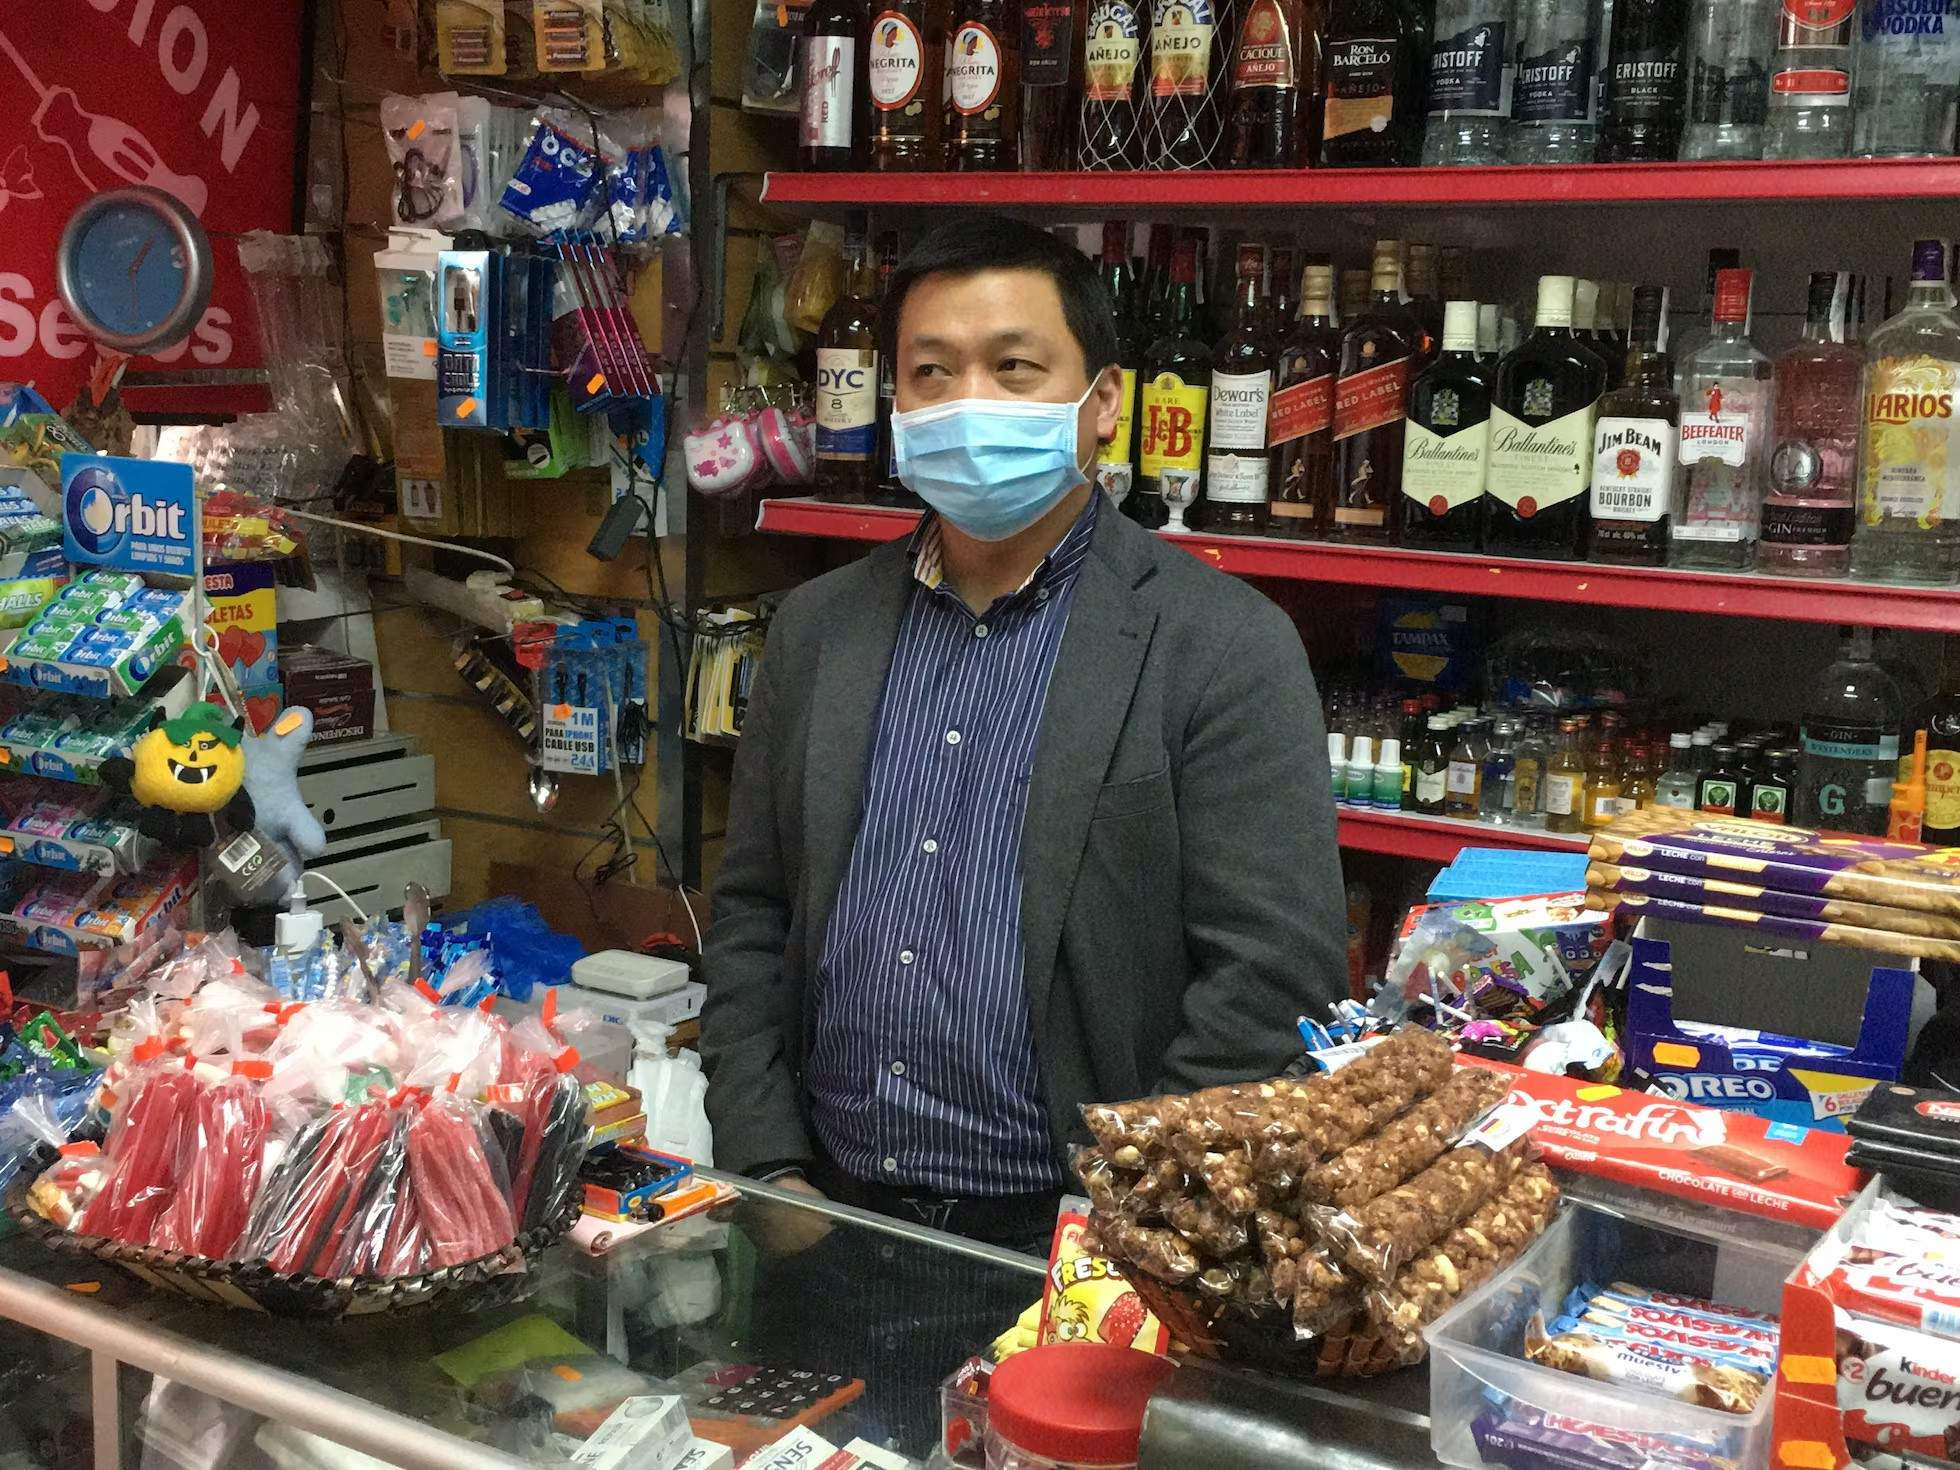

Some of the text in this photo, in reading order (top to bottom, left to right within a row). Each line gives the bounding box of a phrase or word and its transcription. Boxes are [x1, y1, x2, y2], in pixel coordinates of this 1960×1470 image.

[1884, 15, 1943, 35] VODKA
[1155, 34, 1201, 51] AÑEJO
[1350, 44, 1374, 55] RON
[1088, 46, 1130, 61] AÑEJO
[1240, 46, 1285, 60] CACIQUE
[1333, 49, 1391, 67] BARCELÓ
[869, 58, 916, 69] NEGRITA
[1246, 62, 1276, 73] AÑEJO
[1615, 62, 1678, 80] ERISTOFF
[0, 272, 233, 364] Ses
[818, 368, 865, 390] DYC
[1214, 386, 1265, 402] Dewar's
[1336, 395, 1359, 411] RED
[1362, 382, 1401, 401] LABEL
[831, 398, 843, 410] 8
[1272, 405, 1292, 418] RED
[1294, 394, 1328, 411] LABEL
[1869, 393, 1953, 425] LARIOS
[1142, 405, 1193, 458] J&B
[1681, 424, 1745, 443] BEEFEATER
[1493, 425, 1578, 456] Ballantine's
[1598, 428, 1662, 457] JIM BEAM
[1598, 492, 1652, 508] BOURBON
[66, 466, 187, 555] Orbit
[1768, 523, 1792, 535] GIN
[205, 574, 233, 590] ESTA
[1392, 632, 1448, 646] TAMPAX
[545, 727, 564, 738] PARA
[1830, 730, 1853, 740] GIN
[545, 737, 595, 753] CABLE USB
[1818, 783, 1847, 816] G
[1661, 849, 1689, 861] LECHE
[1658, 873, 1686, 884] LECHE
[1824, 1096, 1837, 1112] 6
[1658, 1170, 1730, 1196] CHOCOLATE
[1750, 1189, 1791, 1211] LECHE
[1899, 1356, 1957, 1386] kinder
